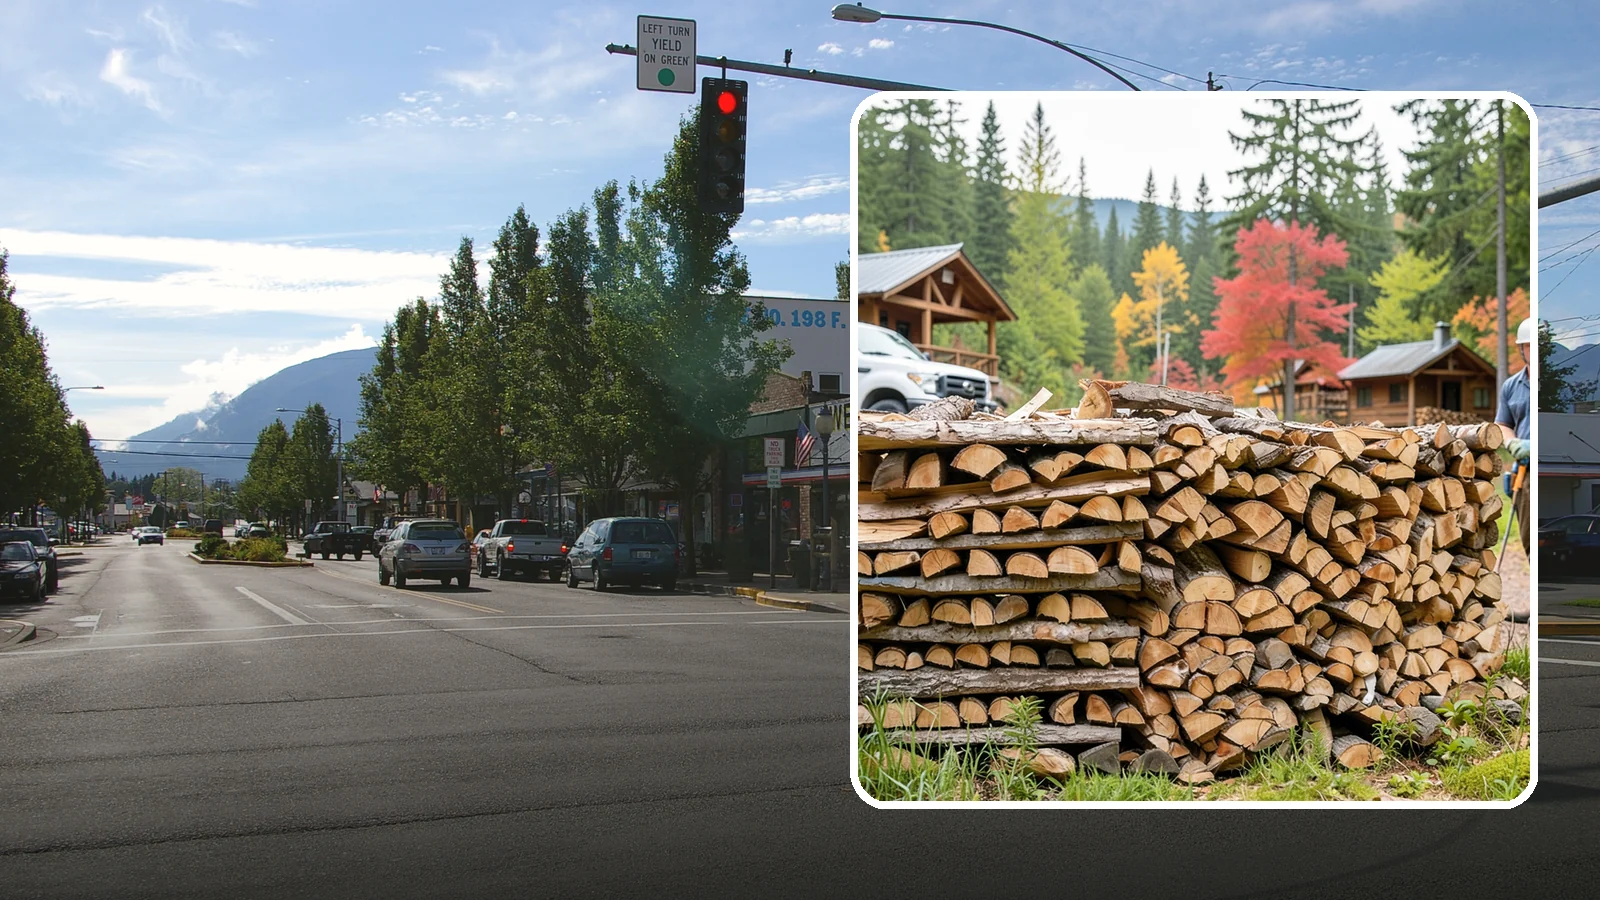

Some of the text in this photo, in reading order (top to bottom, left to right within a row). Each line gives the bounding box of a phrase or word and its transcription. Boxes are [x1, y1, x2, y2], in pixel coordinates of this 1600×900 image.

[643, 23, 690, 36] LEFT TURN
[652, 38, 682, 51] YIELD
[644, 53, 688, 66] ON GREEN
[791, 309, 826, 328] 198
[831, 311, 846, 329] F.
